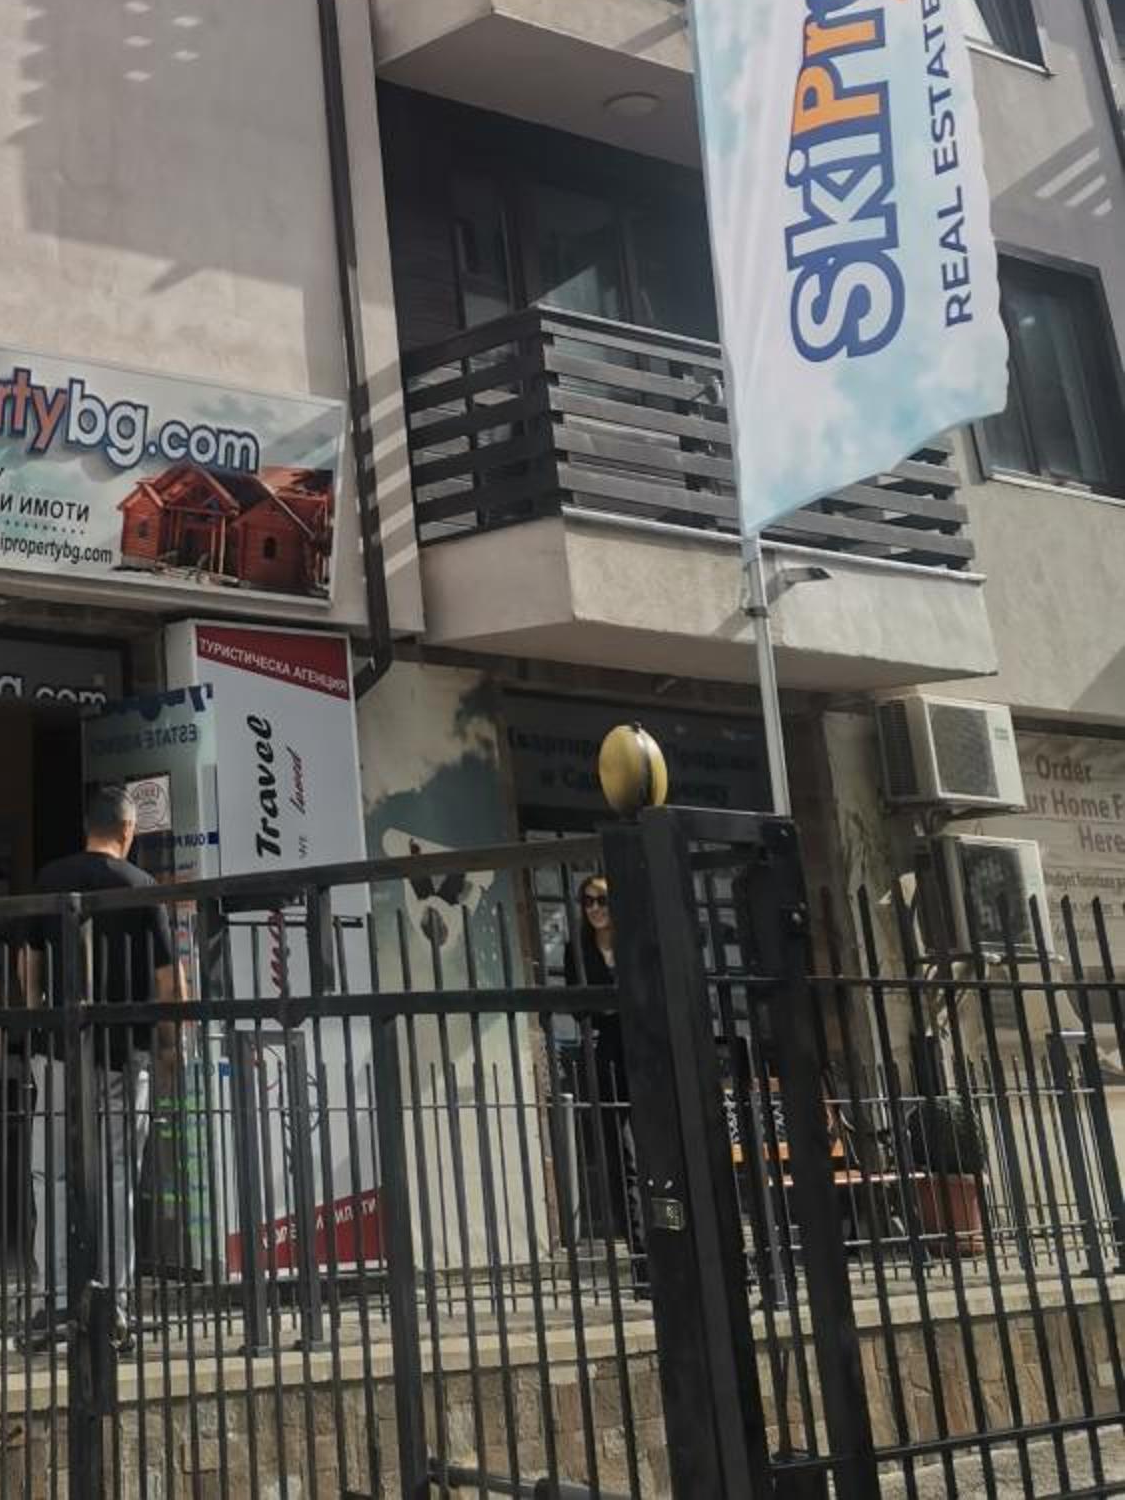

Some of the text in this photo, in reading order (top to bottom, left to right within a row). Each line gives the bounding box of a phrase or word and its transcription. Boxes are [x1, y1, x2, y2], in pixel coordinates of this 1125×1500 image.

[937, 186, 973, 328] REAL
[19, 498, 91, 523] ИМОТИ
[1034, 754, 1092, 784] Order
[246, 714, 282, 858] Travel
[1050, 789, 1110, 820] Home
